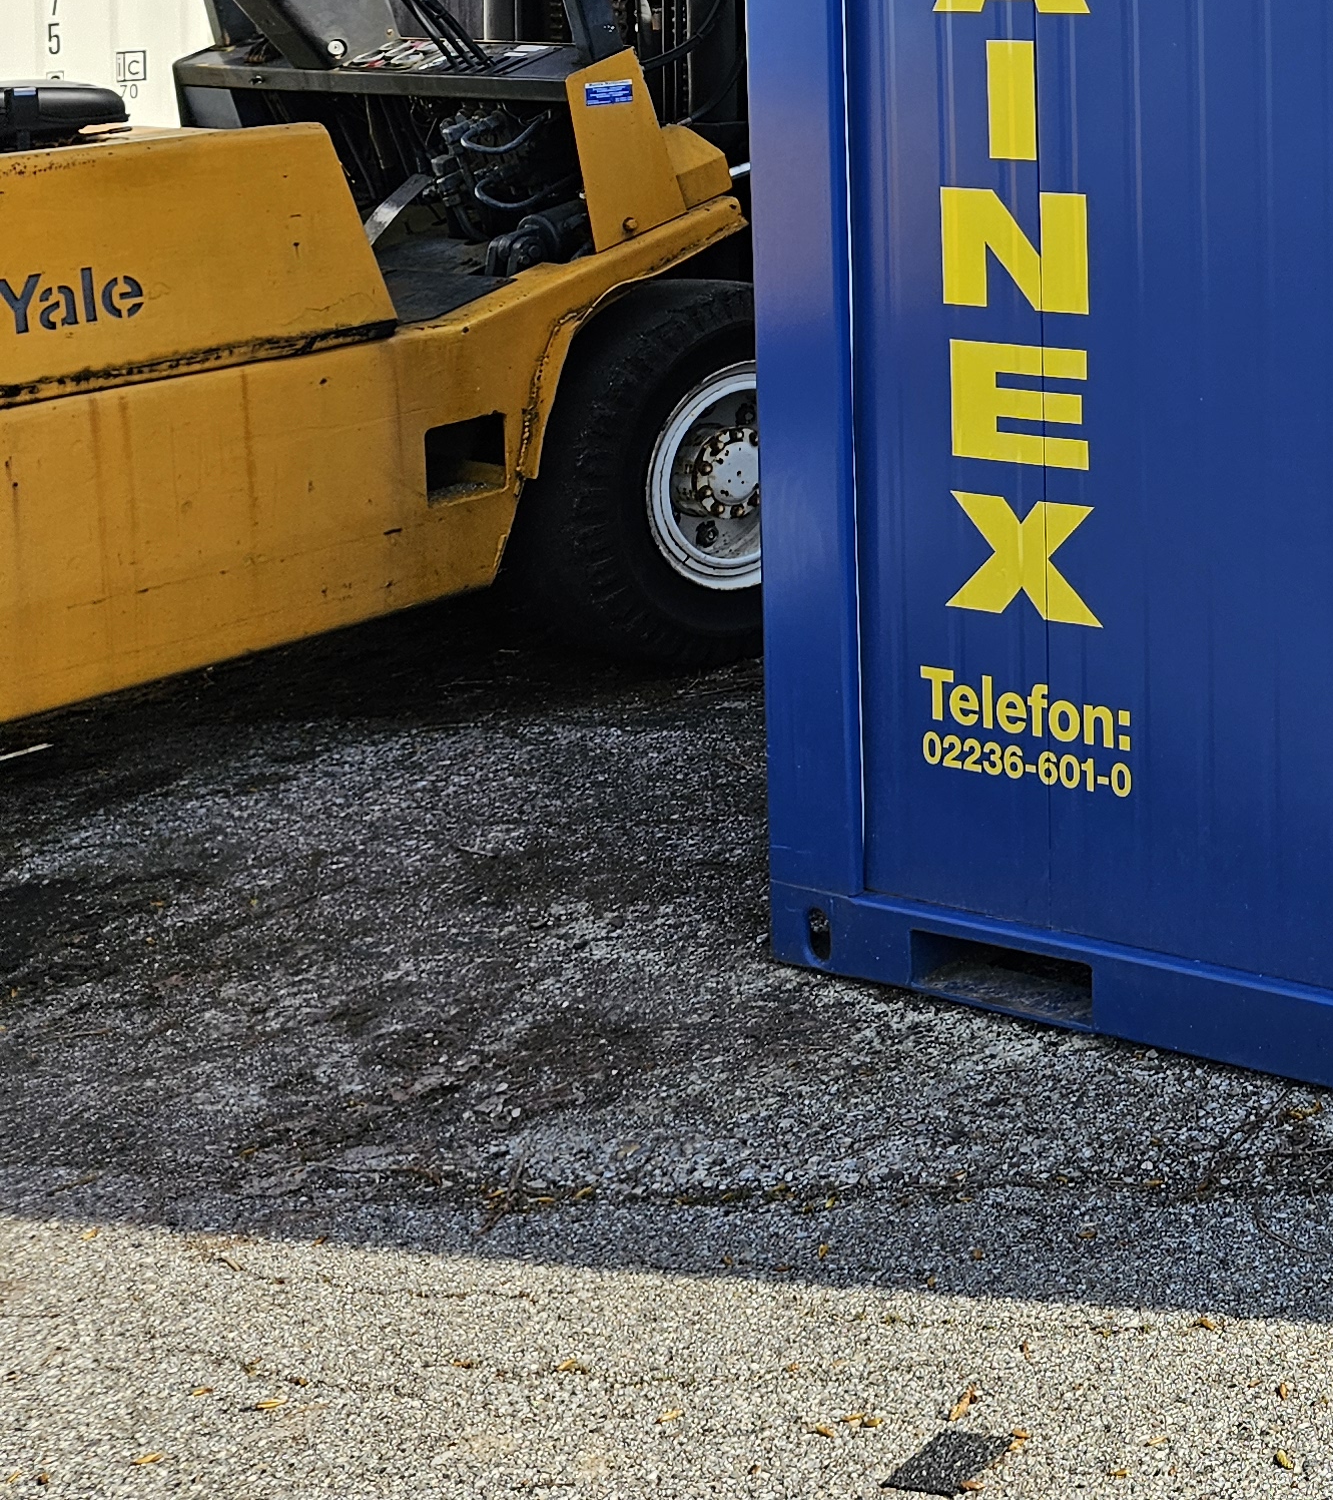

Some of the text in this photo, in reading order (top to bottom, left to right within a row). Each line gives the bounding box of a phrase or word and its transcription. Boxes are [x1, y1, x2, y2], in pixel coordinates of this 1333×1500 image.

[119, 83, 139, 99] 70
[0, 266, 145, 335] Yale
[919, 664, 1132, 752] Telefon:
[922, 730, 1133, 798] 02236-601-0
